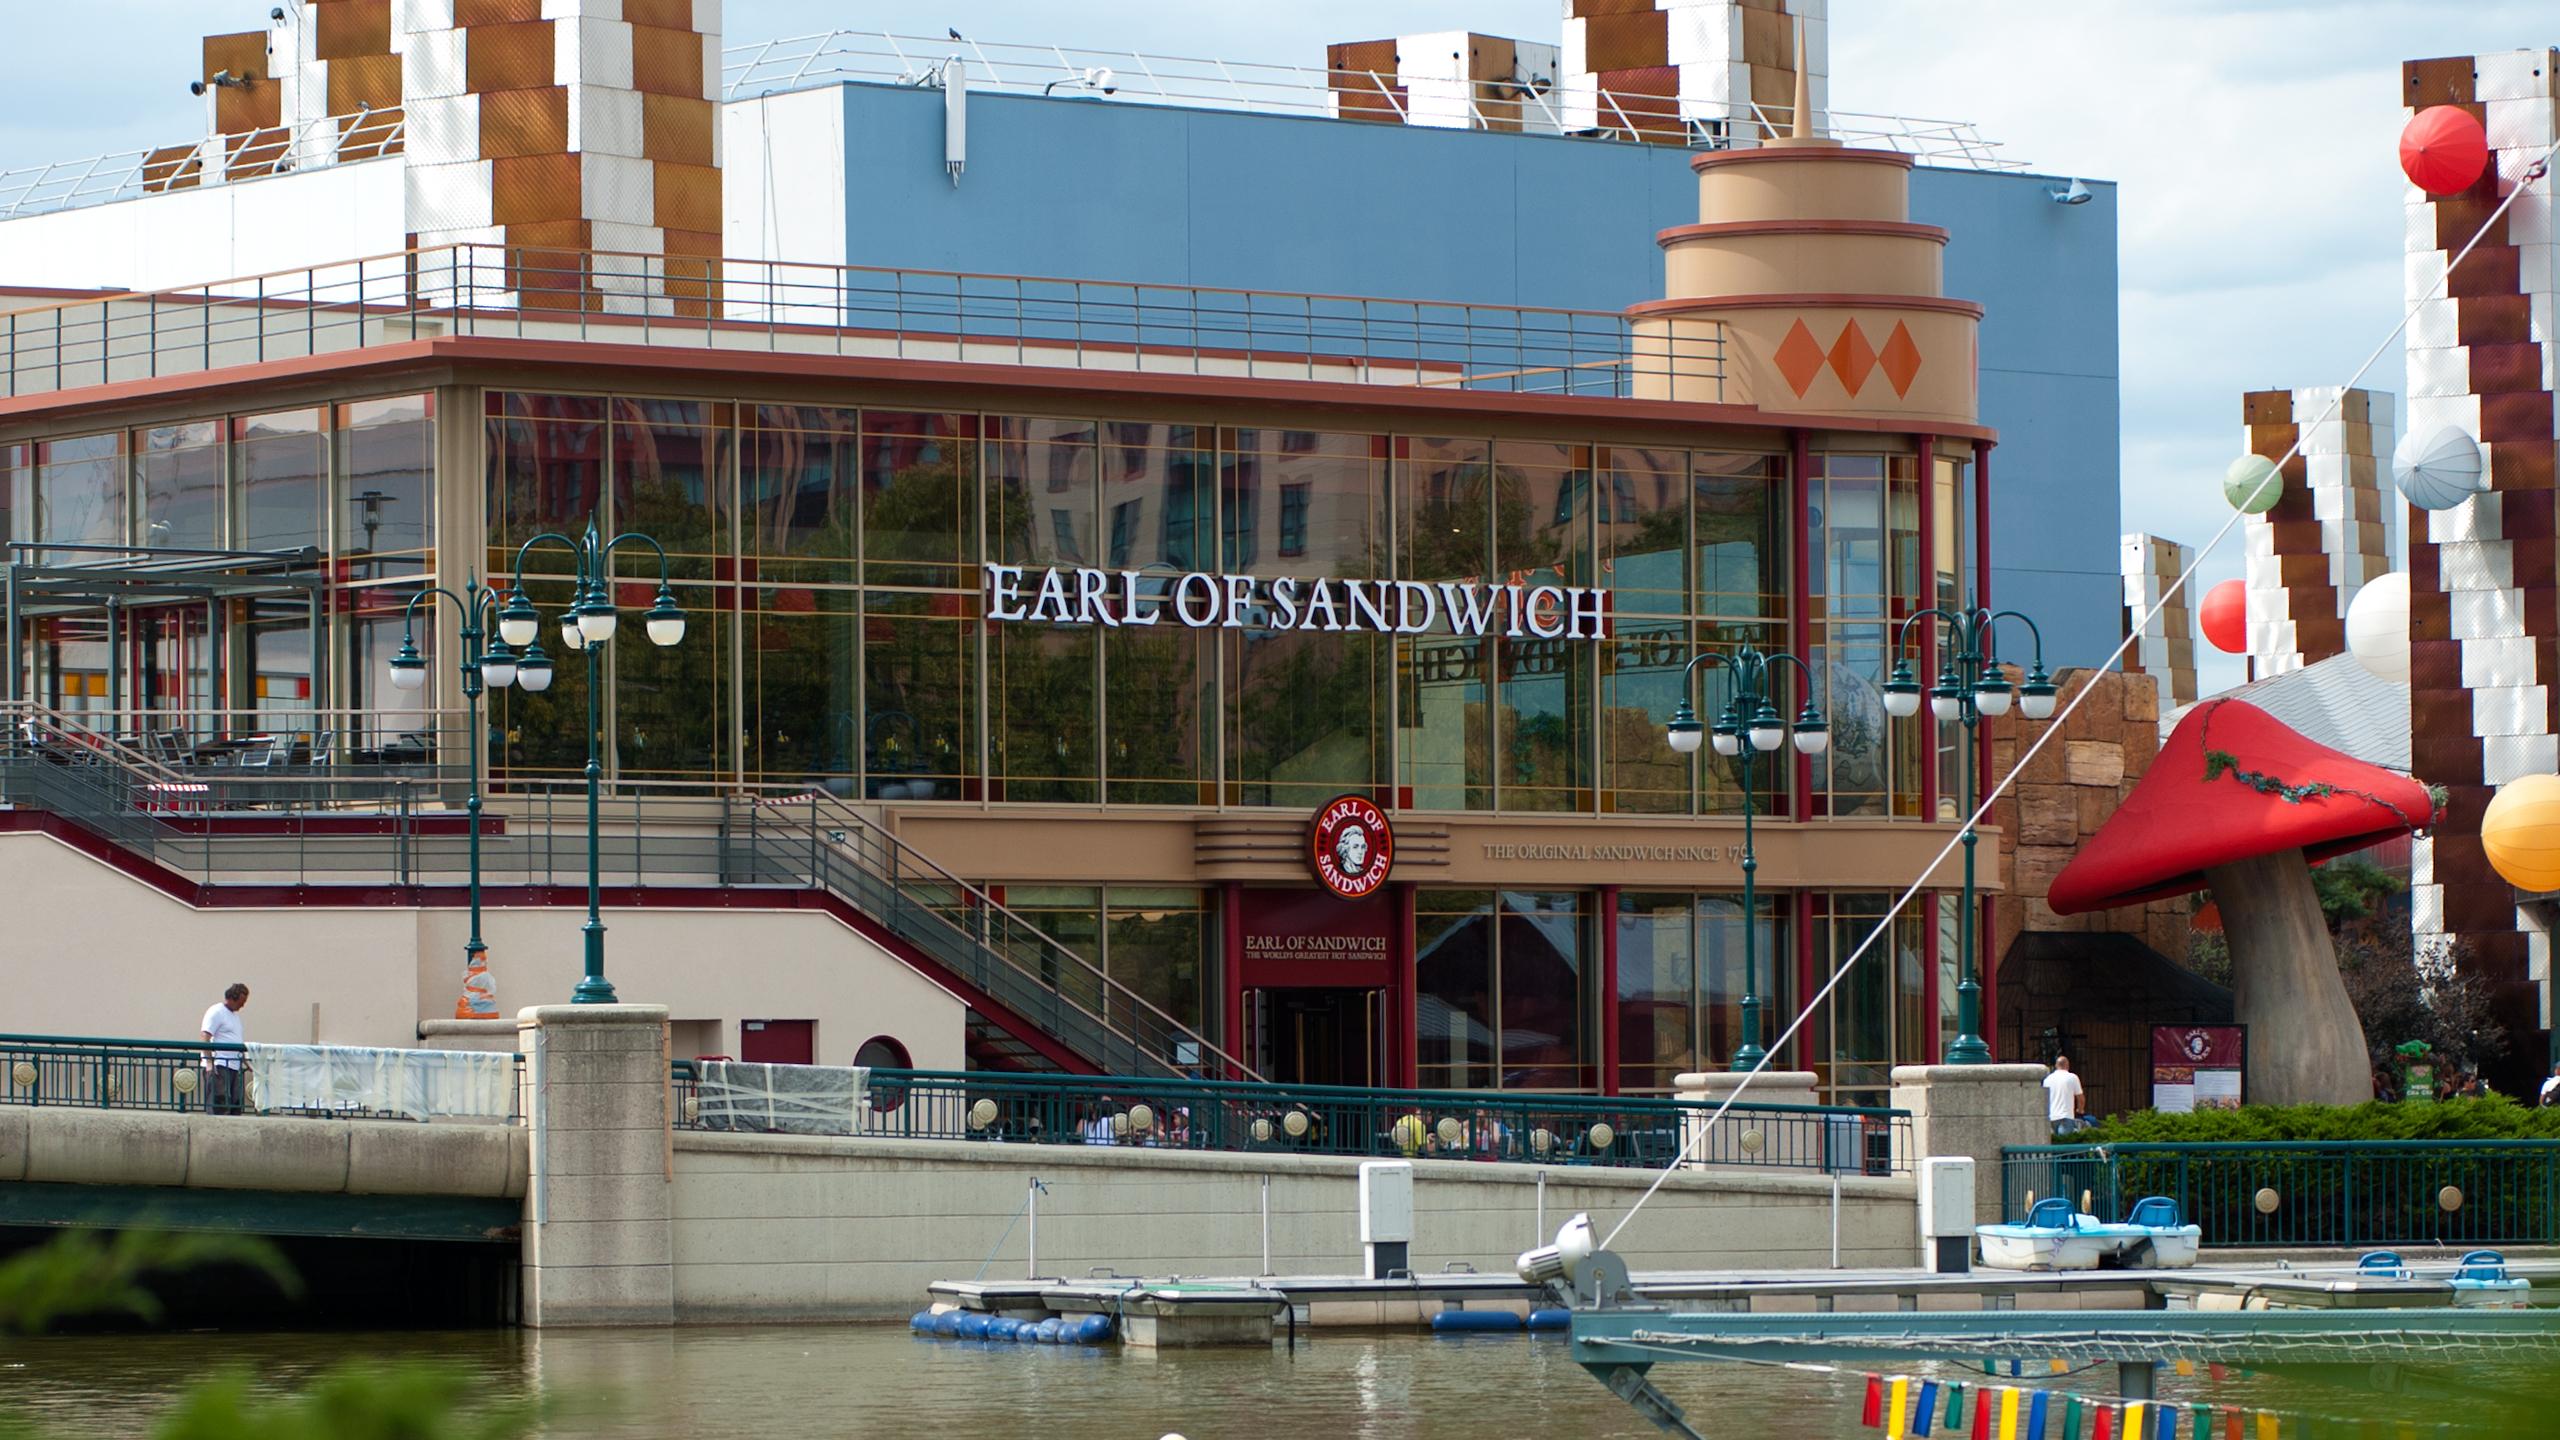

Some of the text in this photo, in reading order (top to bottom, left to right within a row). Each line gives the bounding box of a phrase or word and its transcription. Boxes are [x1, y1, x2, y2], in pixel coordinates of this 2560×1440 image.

[986, 562, 1607, 640] EARL OF SANDWICH
[1322, 802, 1385, 832] EARL OF
[1483, 843, 1514, 860] THE
[1518, 843, 1590, 861] ORIGINAL
[1594, 844, 1675, 862] SANDWICH
[1676, 845, 1719, 861] SINCE
[1319, 853, 1388, 893] SANDWICH
[1246, 935, 1387, 951] EARL OF SANDWICH
[1246, 951, 1261, 959] THE
[1347, 952, 1387, 961] SANDWICH
